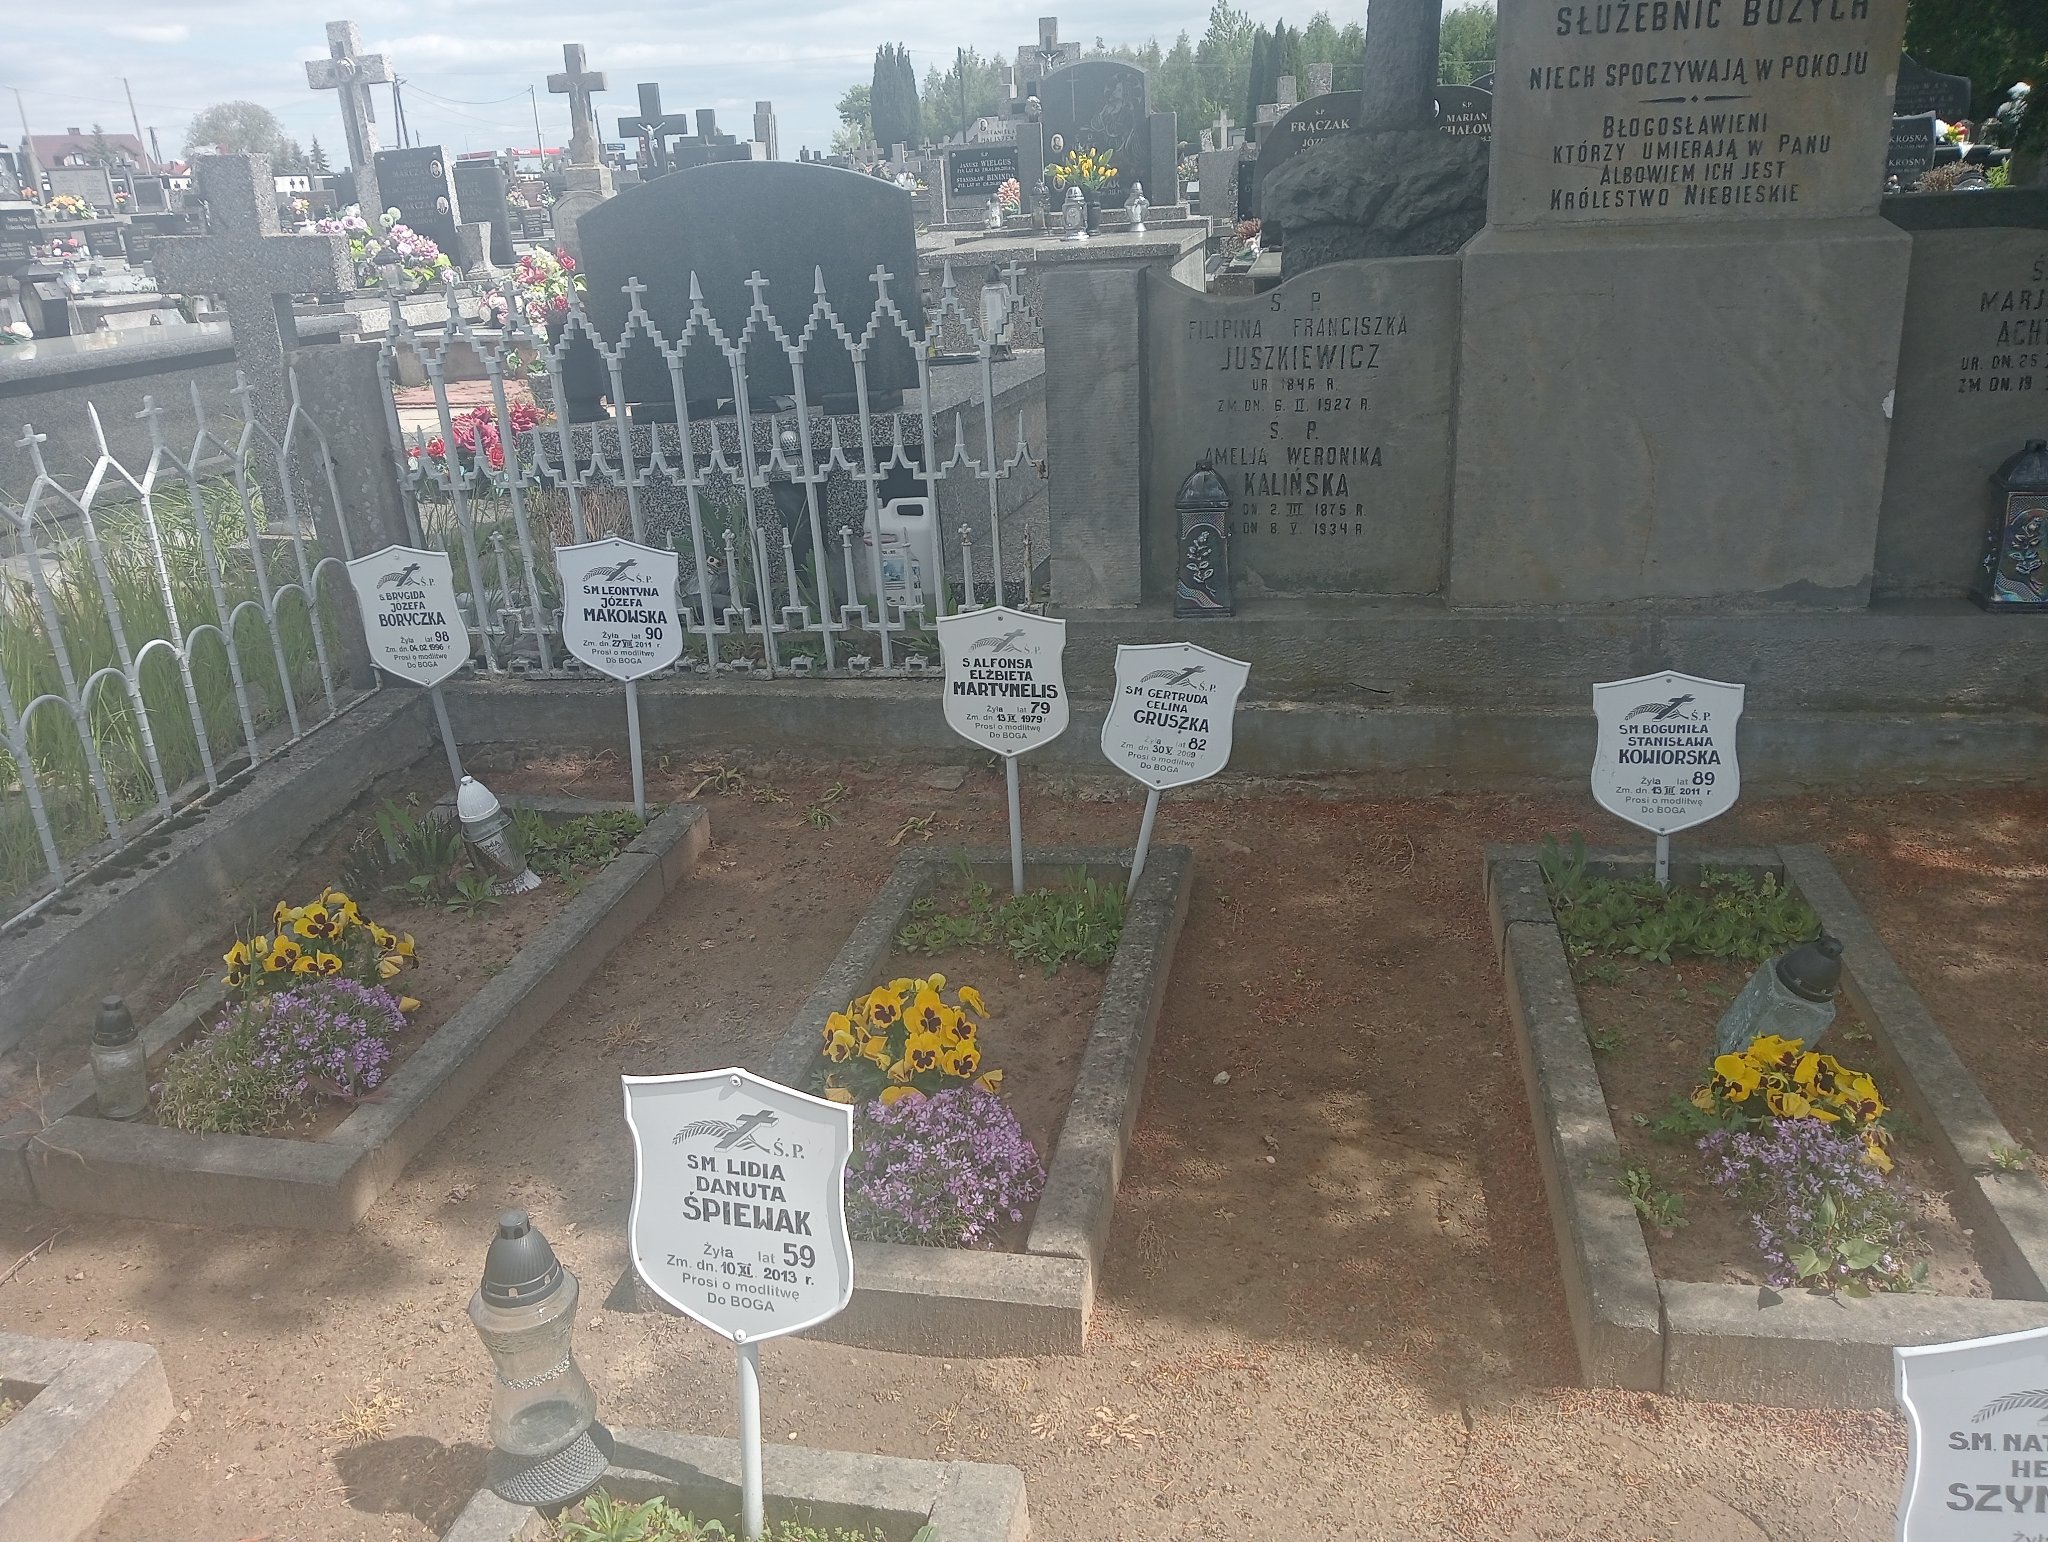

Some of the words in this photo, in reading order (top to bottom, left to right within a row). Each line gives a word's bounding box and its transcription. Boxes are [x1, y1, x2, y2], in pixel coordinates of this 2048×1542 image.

[1557, 0, 1721, 35] SŁUŻEBNIC
[1530, 65, 1595, 90] NIECH
[1605, 57, 1748, 88] SPOCZYWAJĄ
[1757, 58, 1773, 80] W
[1782, 51, 1868, 78] POKOJU
[1446, 112, 1488, 122] MARIAN
[1290, 119, 1350, 133] FRĄCZAK
[1602, 112, 1768, 139] BŁOGOSŁAWIENI
[1553, 140, 1625, 164] KTÓRZY
[1643, 138, 1738, 161] UMIERAJĄ
[1749, 139, 1764, 156] W
[1779, 134, 1831, 154] PANU
[980, 159, 1011, 167] WIELGUS
[1601, 163, 1695, 186] ALBOWIEM
[1704, 163, 1733, 181] ICH
[1741, 160, 1786, 180] JEST
[1550, 187, 1669, 210] KRÓLESTWO
[1684, 183, 1800, 205] NIEBIESKIE
[1980, 289, 2048, 312] MARJ
[1188, 319, 1262, 339] FILIPINA
[1293, 316, 1408, 337] FRANCISZKA
[1997, 319, 2048, 347] ACH
[1221, 344, 1380, 372] JUSZKIEWICZ
[1282, 377, 1315, 391] 1846
[1326, 377, 1338, 391] R.
[1317, 398, 1351, 412] 1927
[1360, 397, 1372, 411] R.
[1306, 421, 1319, 440] P.
[1287, 447, 1383, 466] WERONIKA
[1244, 467, 1349, 497] KALIŃSKA
[1315, 503, 1346, 516] 1875
[1314, 522, 1347, 535] 1934
[386, 591, 426, 601] BRYGIDA
[602, 586, 660, 597] LEONTYNA
[390, 601, 426, 612] JÓZEFA
[601, 595, 643, 608] JÓZEFA
[379, 612, 446, 627] BORYCZKA
[583, 608, 668, 624] MAKOWSKA
[435, 631, 450, 642] 98
[645, 627, 663, 640] 90
[973, 659, 1033, 669] ALFONSA
[969, 668, 1033, 681] ELŻBIETA
[953, 682, 1059, 699] MARTYNELIS
[1148, 688, 1209, 705] GERTRUDA
[1030, 701, 1051, 714] 79
[1146, 700, 1188, 714] CELINA
[996, 713, 1006, 722] 13
[1021, 715, 1043, 723] 1979
[1133, 709, 1210, 733] GRUSZKA
[1690, 709, 1712, 721] Ś.P.
[989, 731, 1001, 739] Do
[1642, 724, 1709, 734] BOGUMIŁA
[1152, 744, 1165, 754] 30
[1188, 737, 1207, 751] 82
[1628, 737, 1714, 747] STANISŁAWA
[1127, 751, 1149, 760] Prosi
[1619, 749, 1721, 765] KOWIORSKA
[1140, 761, 1152, 769] Do
[1154, 764, 1179, 773] BOGA
[1692, 771, 1715, 786] 89
[1651, 786, 1662, 795] 13
[1625, 796, 1650, 804] Prosi
[1660, 798, 1703, 807] modlitwę
[1657, 806, 1687, 814] BOGA
[773, 1138, 805, 1159] Ś.P.
[727, 1158, 786, 1182] LIDIA
[696, 1175, 787, 1203] DANUTA
[682, 1190, 813, 1236] ŚPIEWAK
[703, 1242, 734, 1259] Żyła
[758, 1251, 775, 1264] lat
[783, 1242, 816, 1269] 59
[666, 1254, 692, 1268] Zm.
[697, 1259, 718, 1273] dn.
[763, 1267, 798, 1284] 2013
[805, 1275, 815, 1286] r.
[682, 1272, 718, 1288] Prosi
[722, 1281, 731, 1290] o
[735, 1281, 800, 1302] modlitwę
[707, 1292, 726, 1306] Do
[731, 1295, 776, 1312] BOGA
[1948, 1431, 1997, 1451] S.M.
